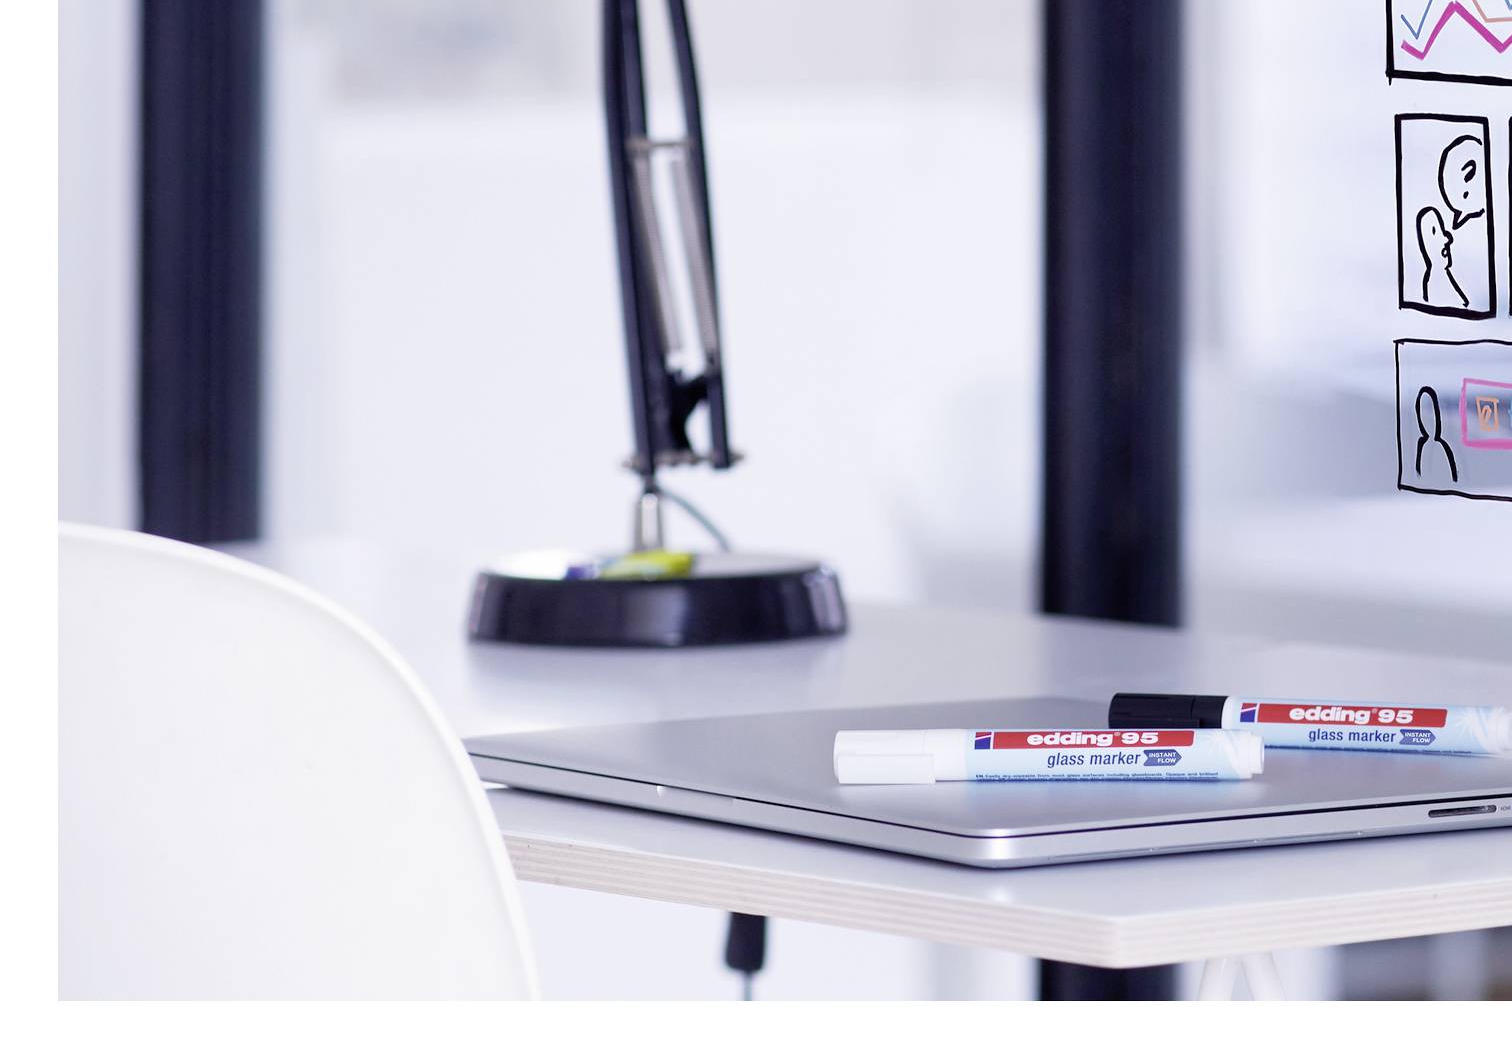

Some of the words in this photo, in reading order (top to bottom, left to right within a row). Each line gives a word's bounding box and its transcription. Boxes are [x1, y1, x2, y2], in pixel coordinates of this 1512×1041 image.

[1289, 706, 1371, 725] edding
[1378, 709, 1414, 724] 95
[1026, 732, 1113, 747] edding
[1121, 732, 1159, 745] 95
[1308, 728, 1344, 743] glass
[1348, 730, 1397, 743] marker
[1047, 753, 1085, 768] glass
[1089, 752, 1142, 766] marker
